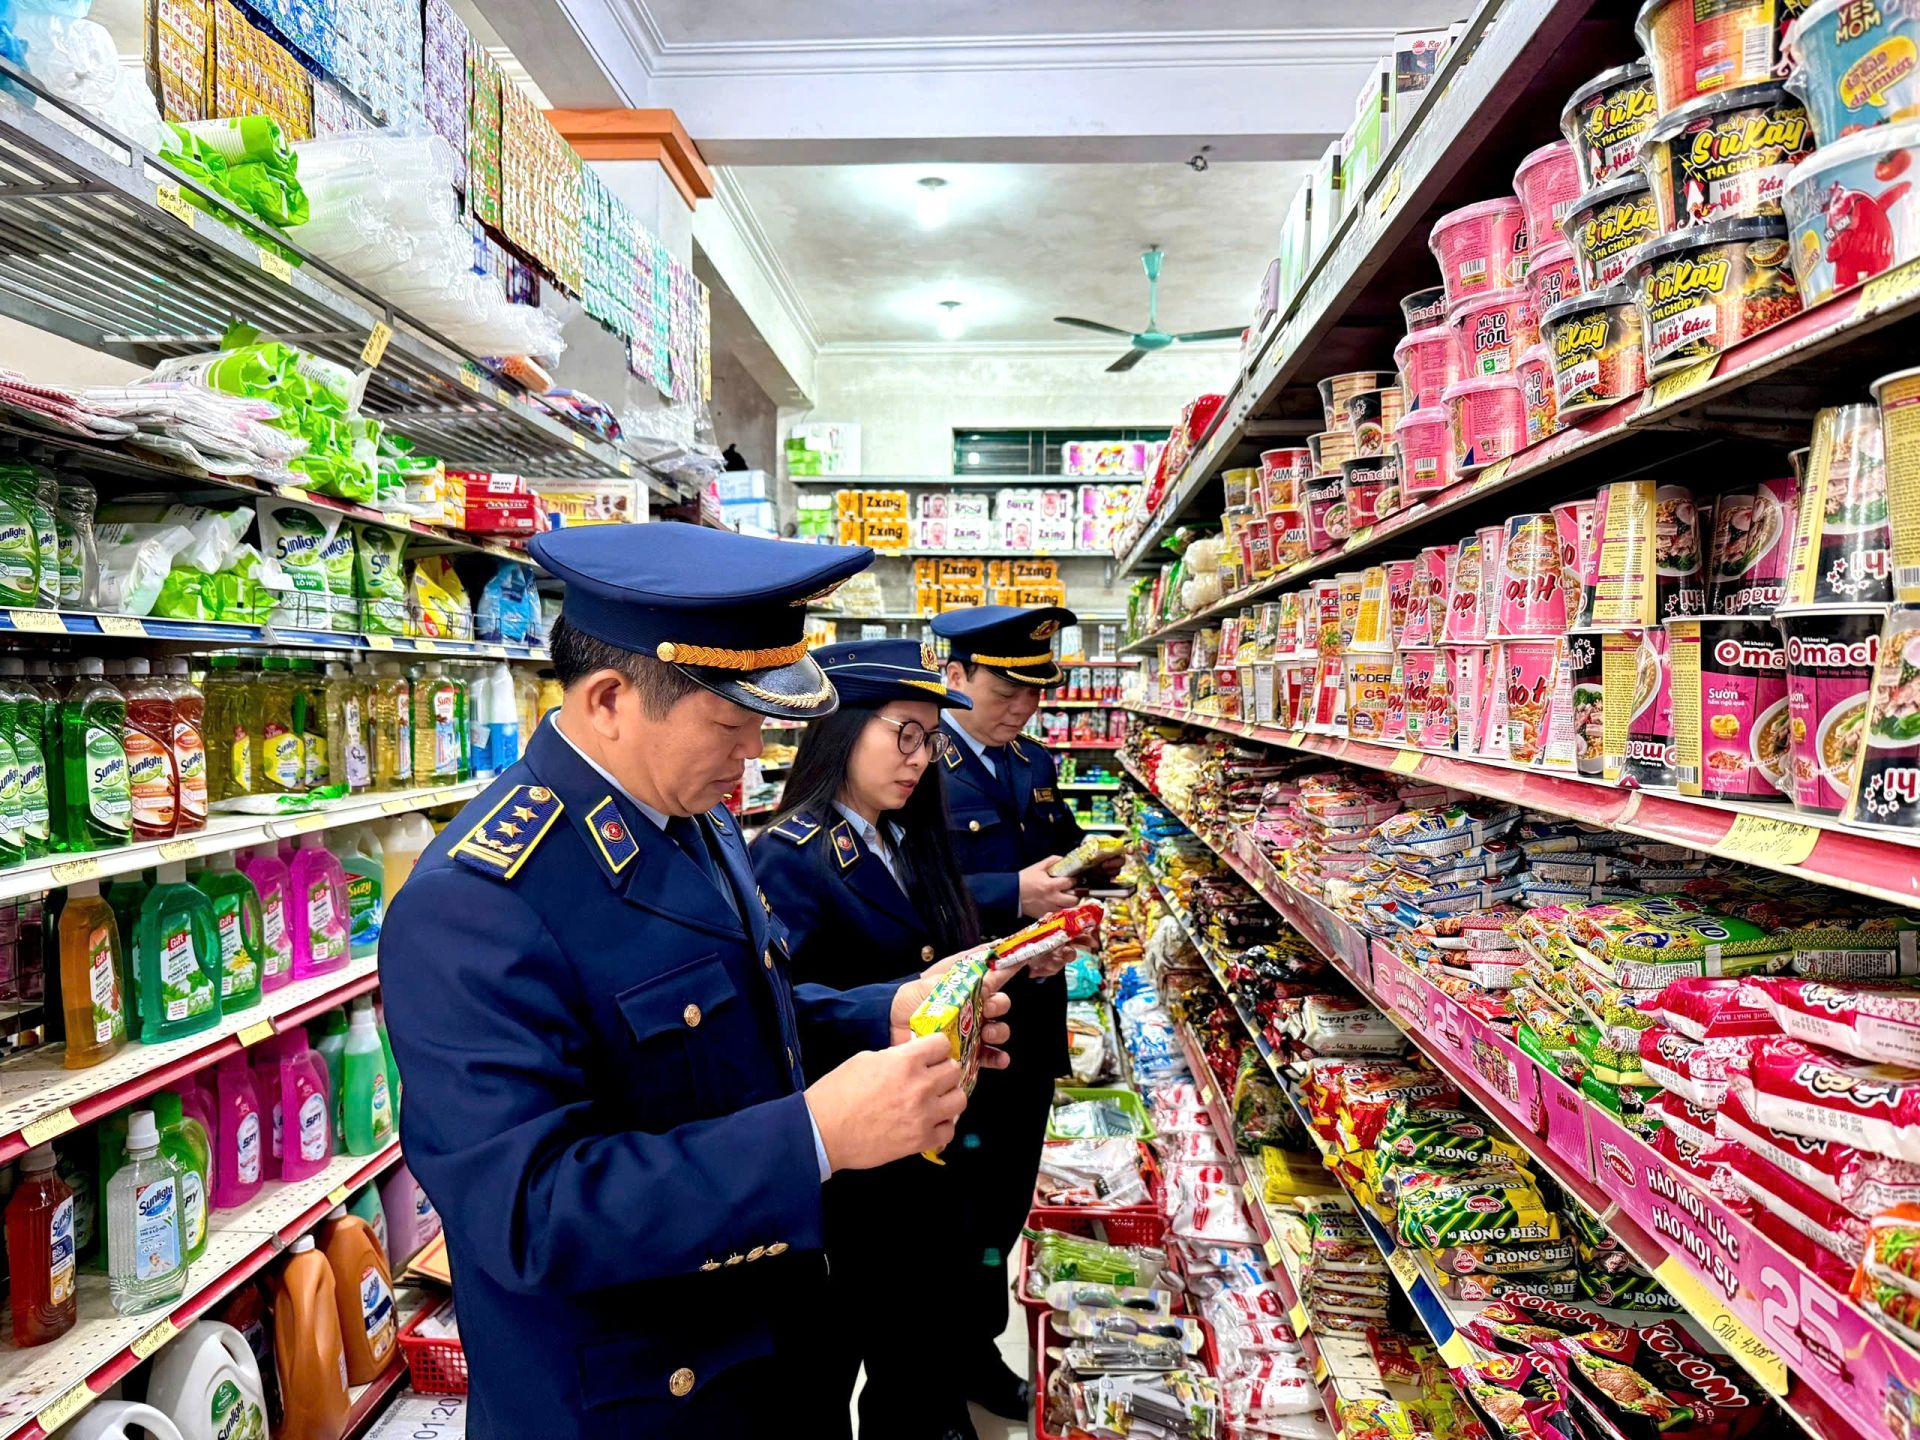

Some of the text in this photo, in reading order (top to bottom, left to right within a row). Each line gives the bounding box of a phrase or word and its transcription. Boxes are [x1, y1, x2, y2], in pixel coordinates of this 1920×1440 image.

[1839, 0, 1875, 24] YES
[1835, 10, 1882, 45] MOM
[1657, 323, 1681, 351] Hải
[1682, 317, 1711, 337] Sản
[1272, 468, 1310, 482] KIMCHI
[1351, 466, 1396, 483] Omachi
[866, 496, 901, 511] Zxing
[868, 525, 903, 540] Zxing
[942, 563, 977, 577] Zxing
[1018, 564, 1052, 577] Zxing
[945, 592, 979, 606] Zxing
[1025, 592, 1058, 605] Zxing
[1708, 689, 1739, 700] Sườn
[95, 758, 124, 783] Sunlight
[348, 881, 371, 897] Suzy
[219, 914, 233, 927] Gift
[169, 934, 186, 949] Gift
[1435, 1145, 1478, 1161] RONG
[139, 1185, 173, 1216] Sunlight
[1646, 1164, 1740, 1261] HẢO MỌI LÚC
[1459, 1227, 1506, 1242] RONG
[1510, 1221, 1549, 1239] BIỂN
[1496, 1250, 1541, 1263] RONG
[1651, 1204, 1740, 1298] HẢO MỌI SỰ
[1502, 1290, 1608, 1332] KOKOM
[1760, 1266, 1846, 1366] 25
[217, 1400, 245, 1440] Sunlight
